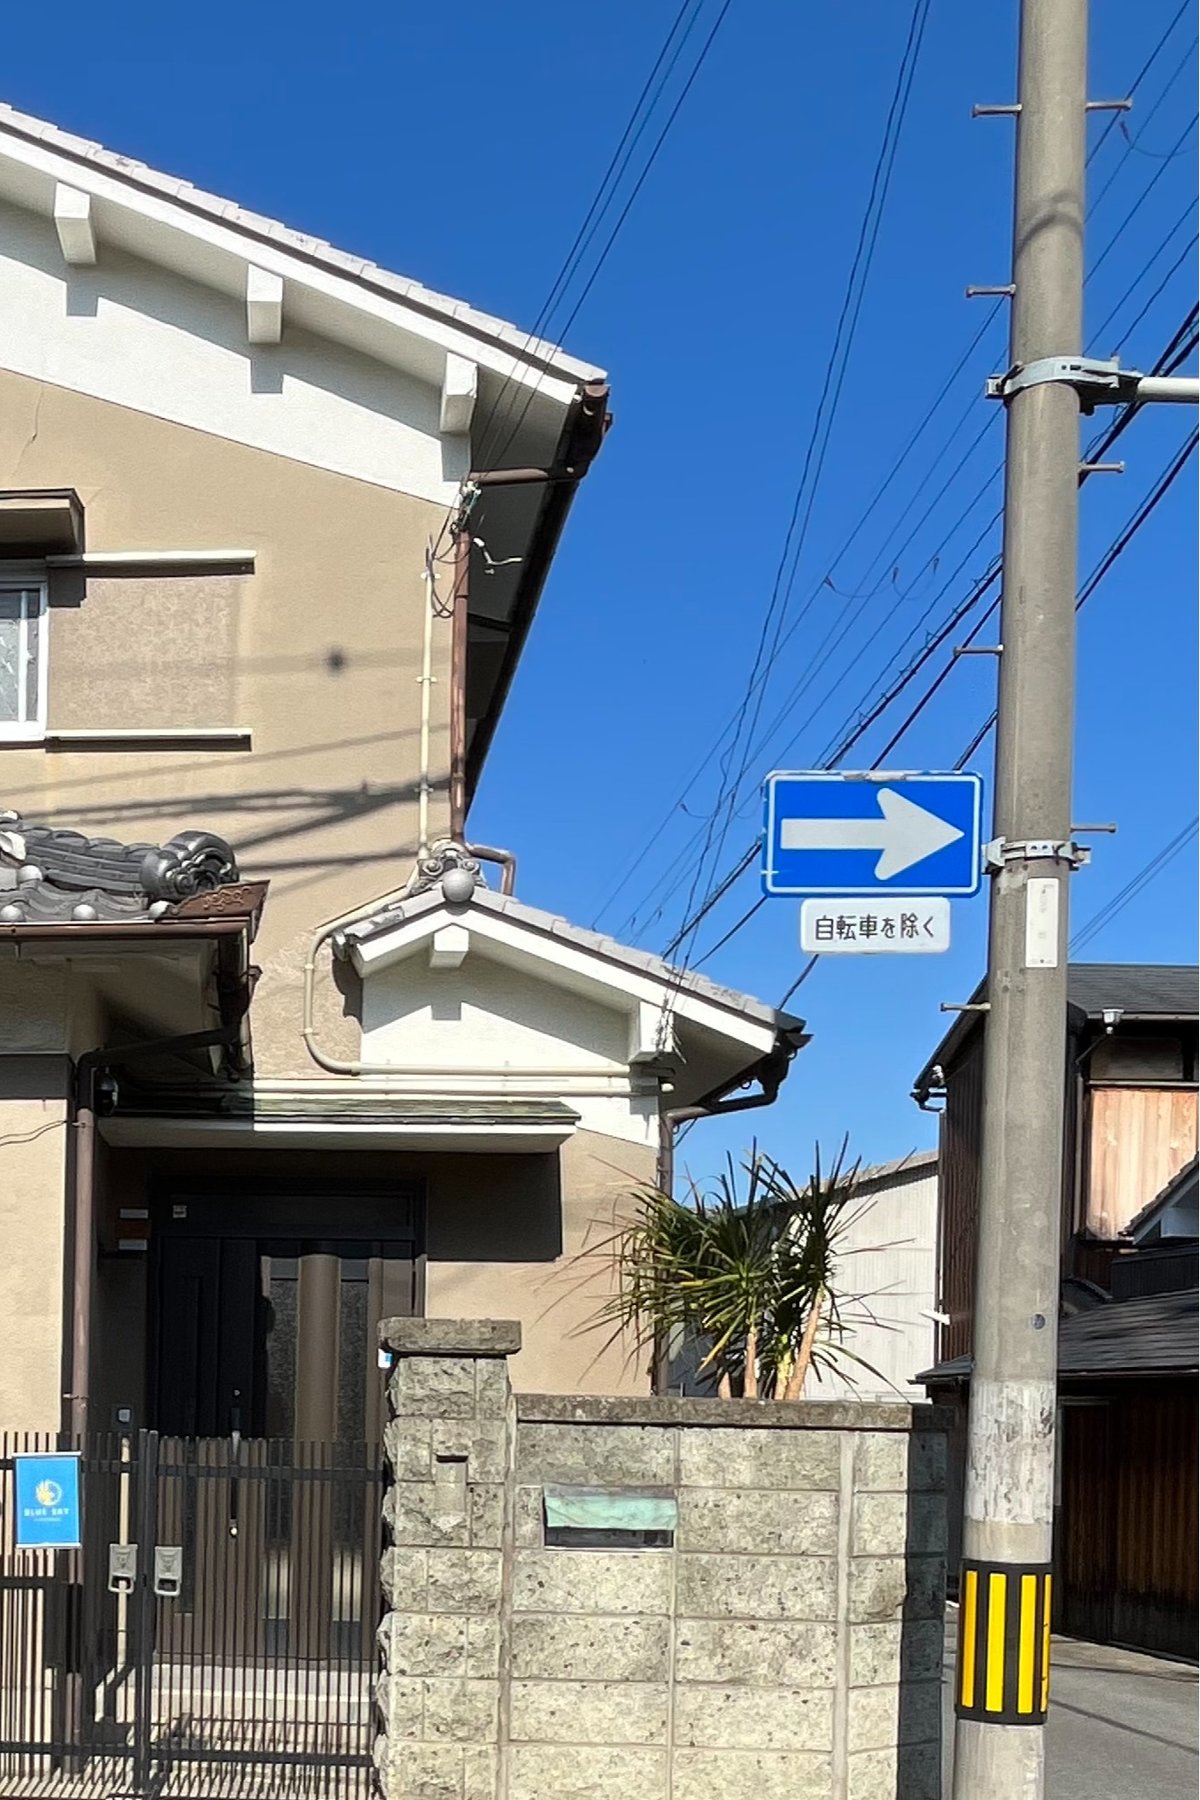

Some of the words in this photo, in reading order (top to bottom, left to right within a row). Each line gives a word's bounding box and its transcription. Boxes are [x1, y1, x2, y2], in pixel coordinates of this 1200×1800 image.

[815, 912, 934, 941] 自転車を除く
[23, 1507, 47, 1517] BLUE
